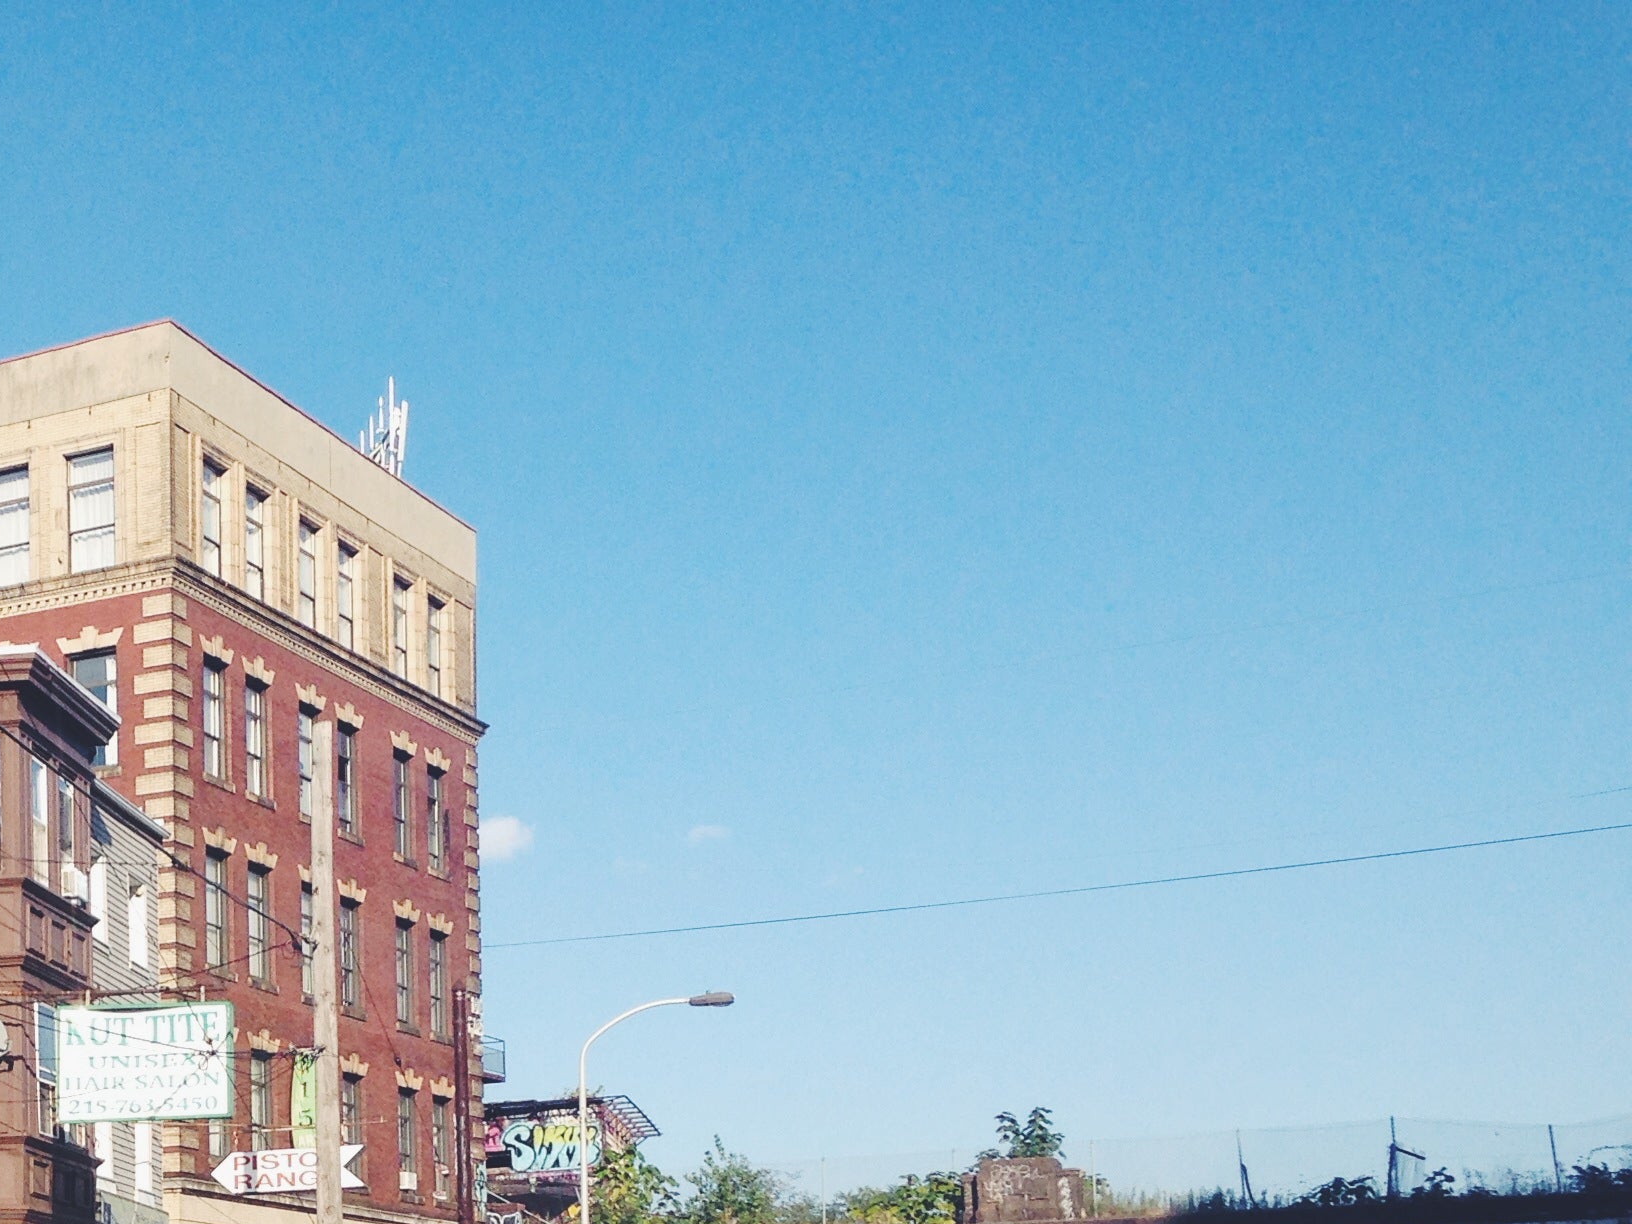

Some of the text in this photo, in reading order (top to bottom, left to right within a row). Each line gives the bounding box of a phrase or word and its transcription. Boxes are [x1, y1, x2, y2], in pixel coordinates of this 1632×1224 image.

[65, 1012, 220, 1046] KUT TITE
[88, 1053, 196, 1070] UNISEX
[65, 1072, 220, 1091] HAIR SALON
